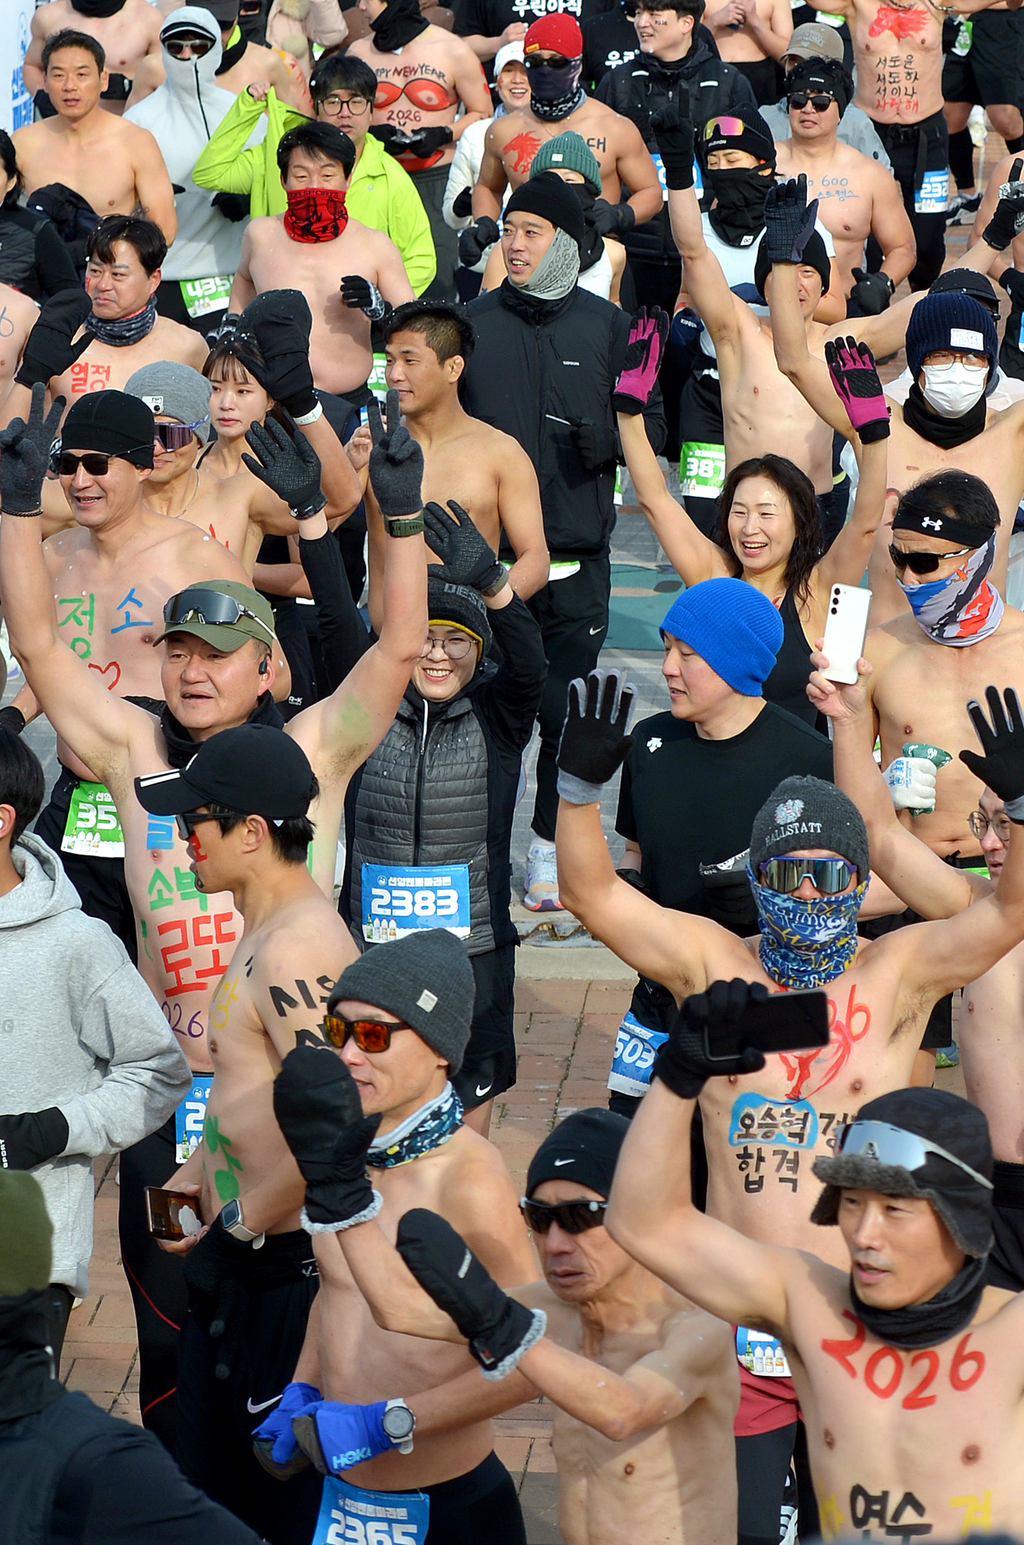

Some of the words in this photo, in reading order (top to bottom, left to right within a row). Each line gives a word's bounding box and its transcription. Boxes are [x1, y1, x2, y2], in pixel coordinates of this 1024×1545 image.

[392, 64, 419, 78] NEW
[417, 63, 448, 83] YEAR
[875, 55, 916, 70] 서도윤
[875, 85, 917, 99] 서이나
[387, 109, 422, 123] 2026
[875, 98, 920, 113] 사랑해
[821, 174, 849, 187] 600
[187, 277, 234, 298] 435
[70, 362, 111, 394] 열정
[685, 457, 726, 478] 387
[764, 821, 823, 847] HALLSTATT
[371, 887, 459, 917] 2383
[736, 1106, 810, 1145] 오승혁
[735, 1145, 801, 1194] 합격
[821, 1309, 986, 1410] 2026
[332, 1446, 372, 1469] HOKA
[326, 1508, 419, 1545] 2365
